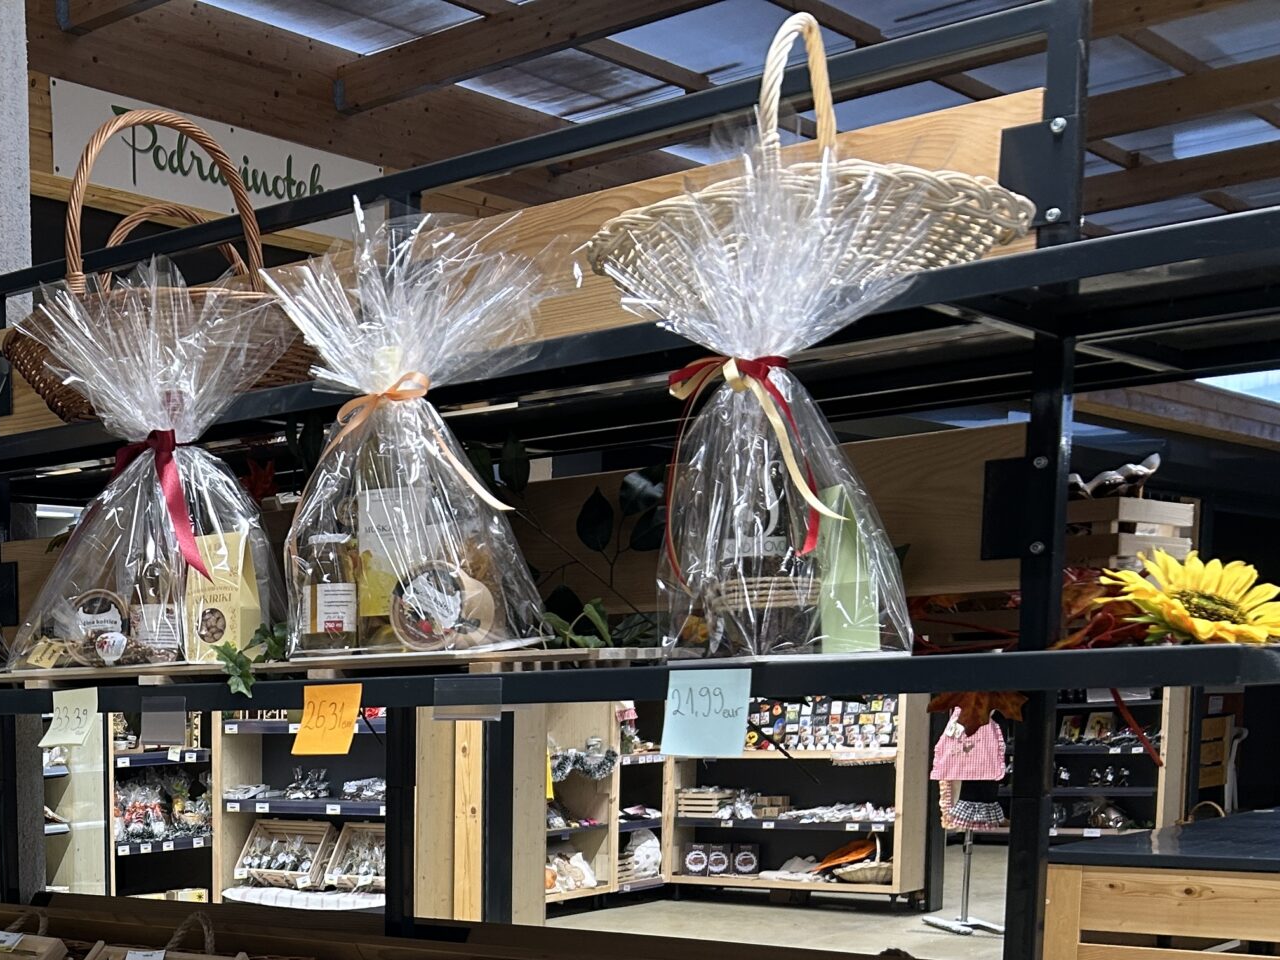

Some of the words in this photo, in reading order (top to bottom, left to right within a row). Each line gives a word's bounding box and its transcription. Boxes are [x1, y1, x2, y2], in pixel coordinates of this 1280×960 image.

[304, 700, 346, 739] 26,31
[671, 686, 725, 718] 21,99
[722, 706, 743, 718] eur
